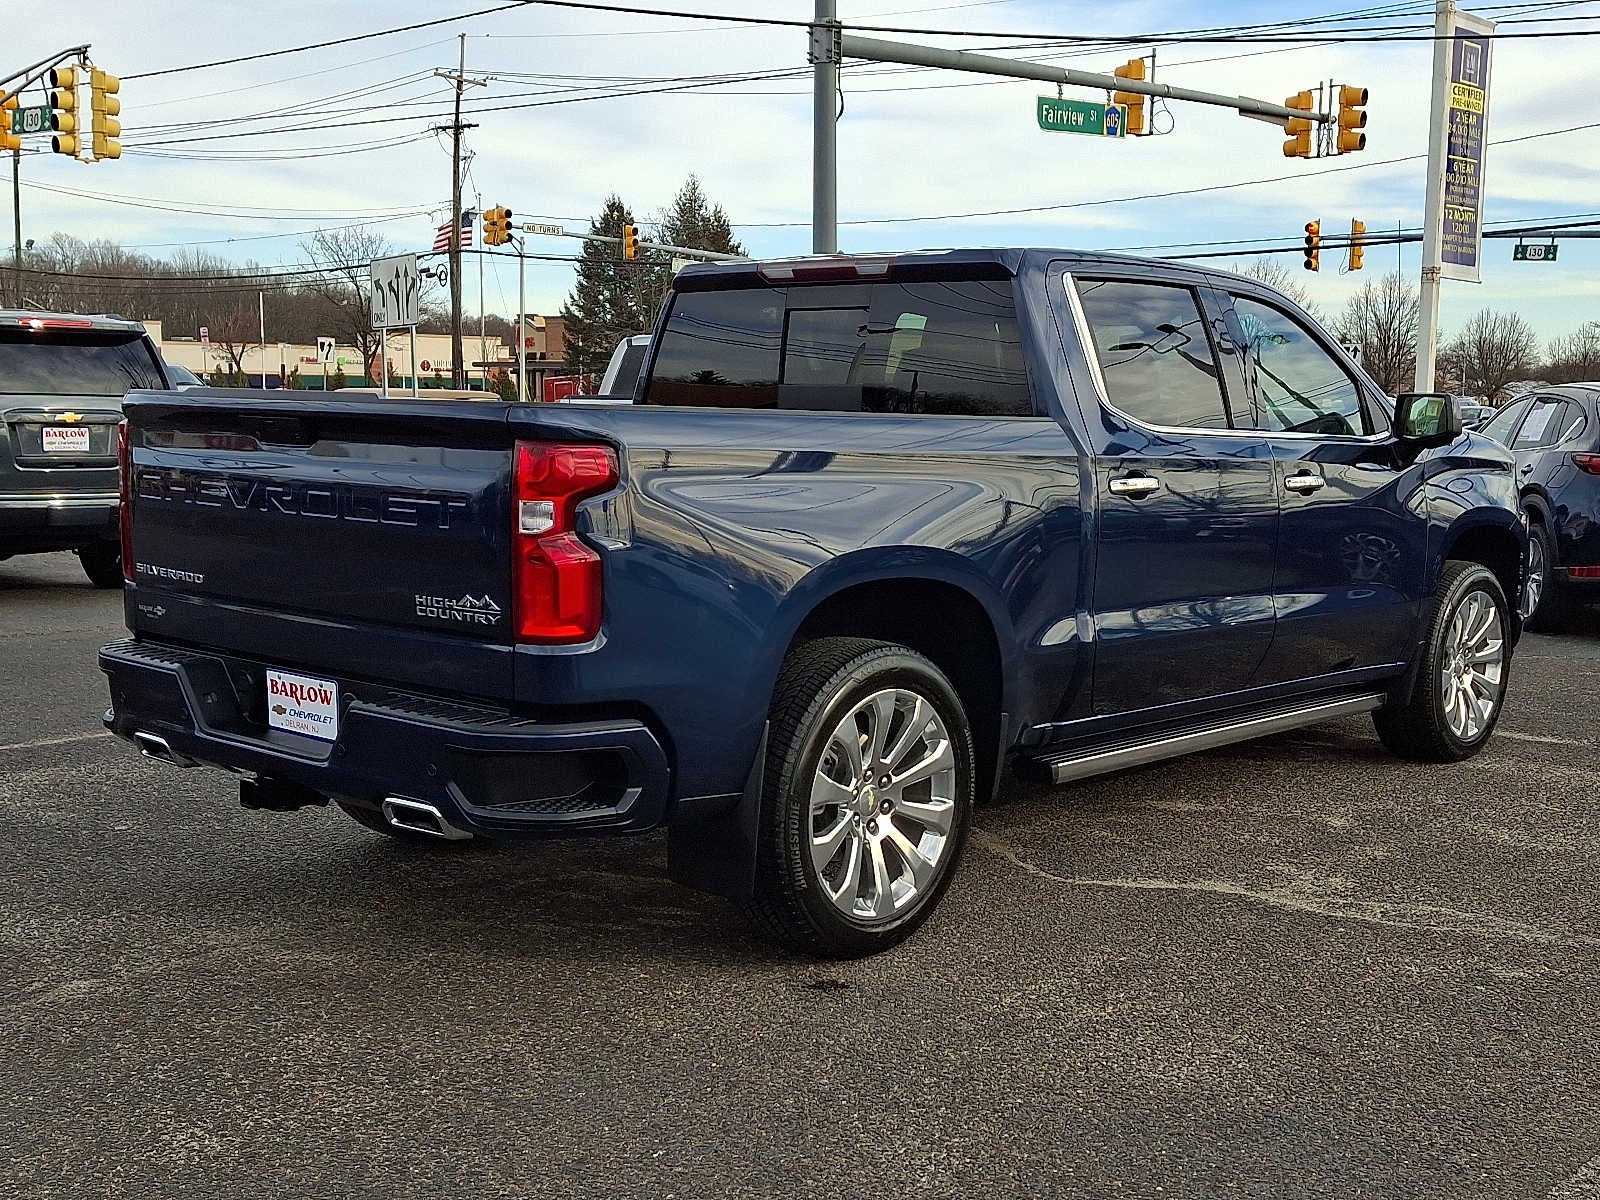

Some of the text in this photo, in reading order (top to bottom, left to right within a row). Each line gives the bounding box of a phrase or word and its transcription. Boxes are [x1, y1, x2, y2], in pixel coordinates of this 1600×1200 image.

[1452, 85, 1482, 101] CERTIFIED
[26, 112, 39, 129] 130
[1042, 104, 1085, 126] Fairview
[1106, 113, 1119, 128] 605
[1456, 111, 1461, 122] 2
[1453, 161, 1458, 171] 6
[538, 225, 560, 235] TURNS
[1529, 248, 1543, 257] 130
[45, 430, 87, 440] BARLOW
[136, 473, 467, 529] CHEVROLET
[135, 562, 204, 583] SILVERADO
[415, 594, 457, 608] HIGH
[416, 605, 501, 625] COUNTRY
[269, 678, 334, 707] BARLOW
[288, 708, 335, 725] CHEVROLET
